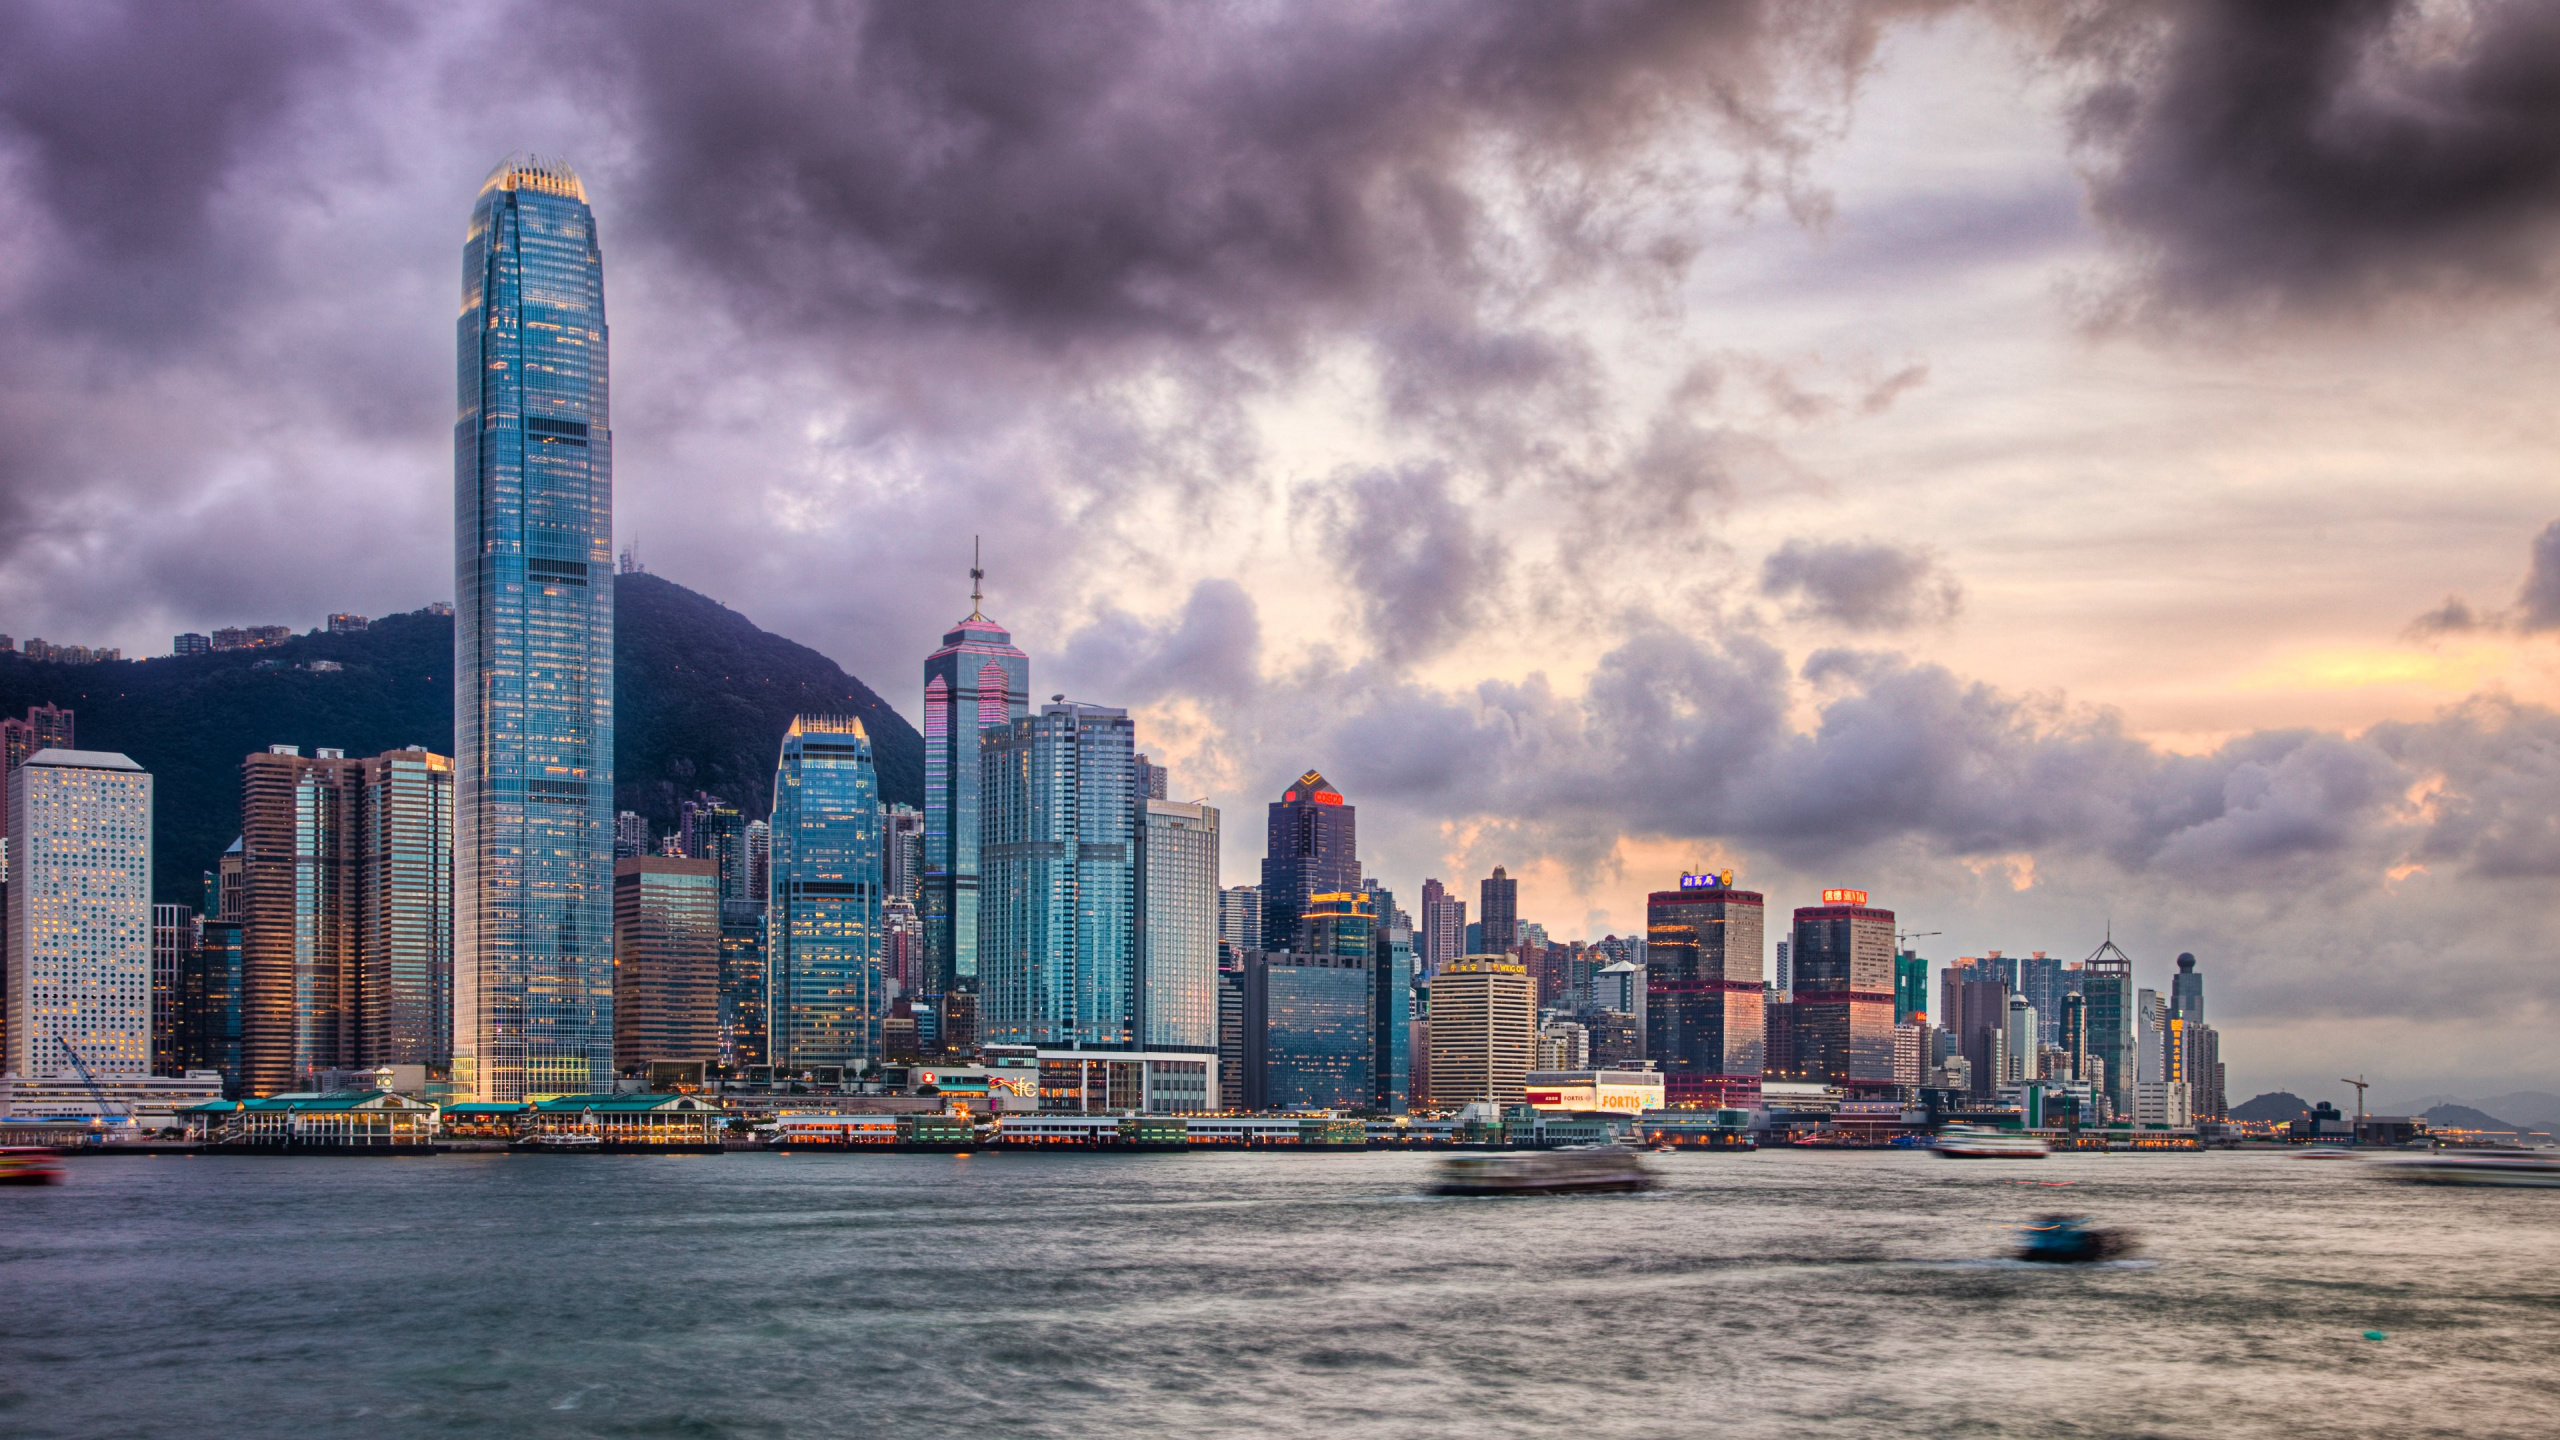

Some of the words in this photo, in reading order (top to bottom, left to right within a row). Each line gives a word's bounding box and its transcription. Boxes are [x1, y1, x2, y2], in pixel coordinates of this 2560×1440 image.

[1315, 792, 1343, 805] COSCO
[1683, 876, 1713, 886] 招商局
[1824, 890, 1842, 901] 信德
[1856, 891, 1866, 903] TAK
[1013, 1077, 1037, 1098] ifc
[1602, 1095, 1640, 1109] FORTIS
